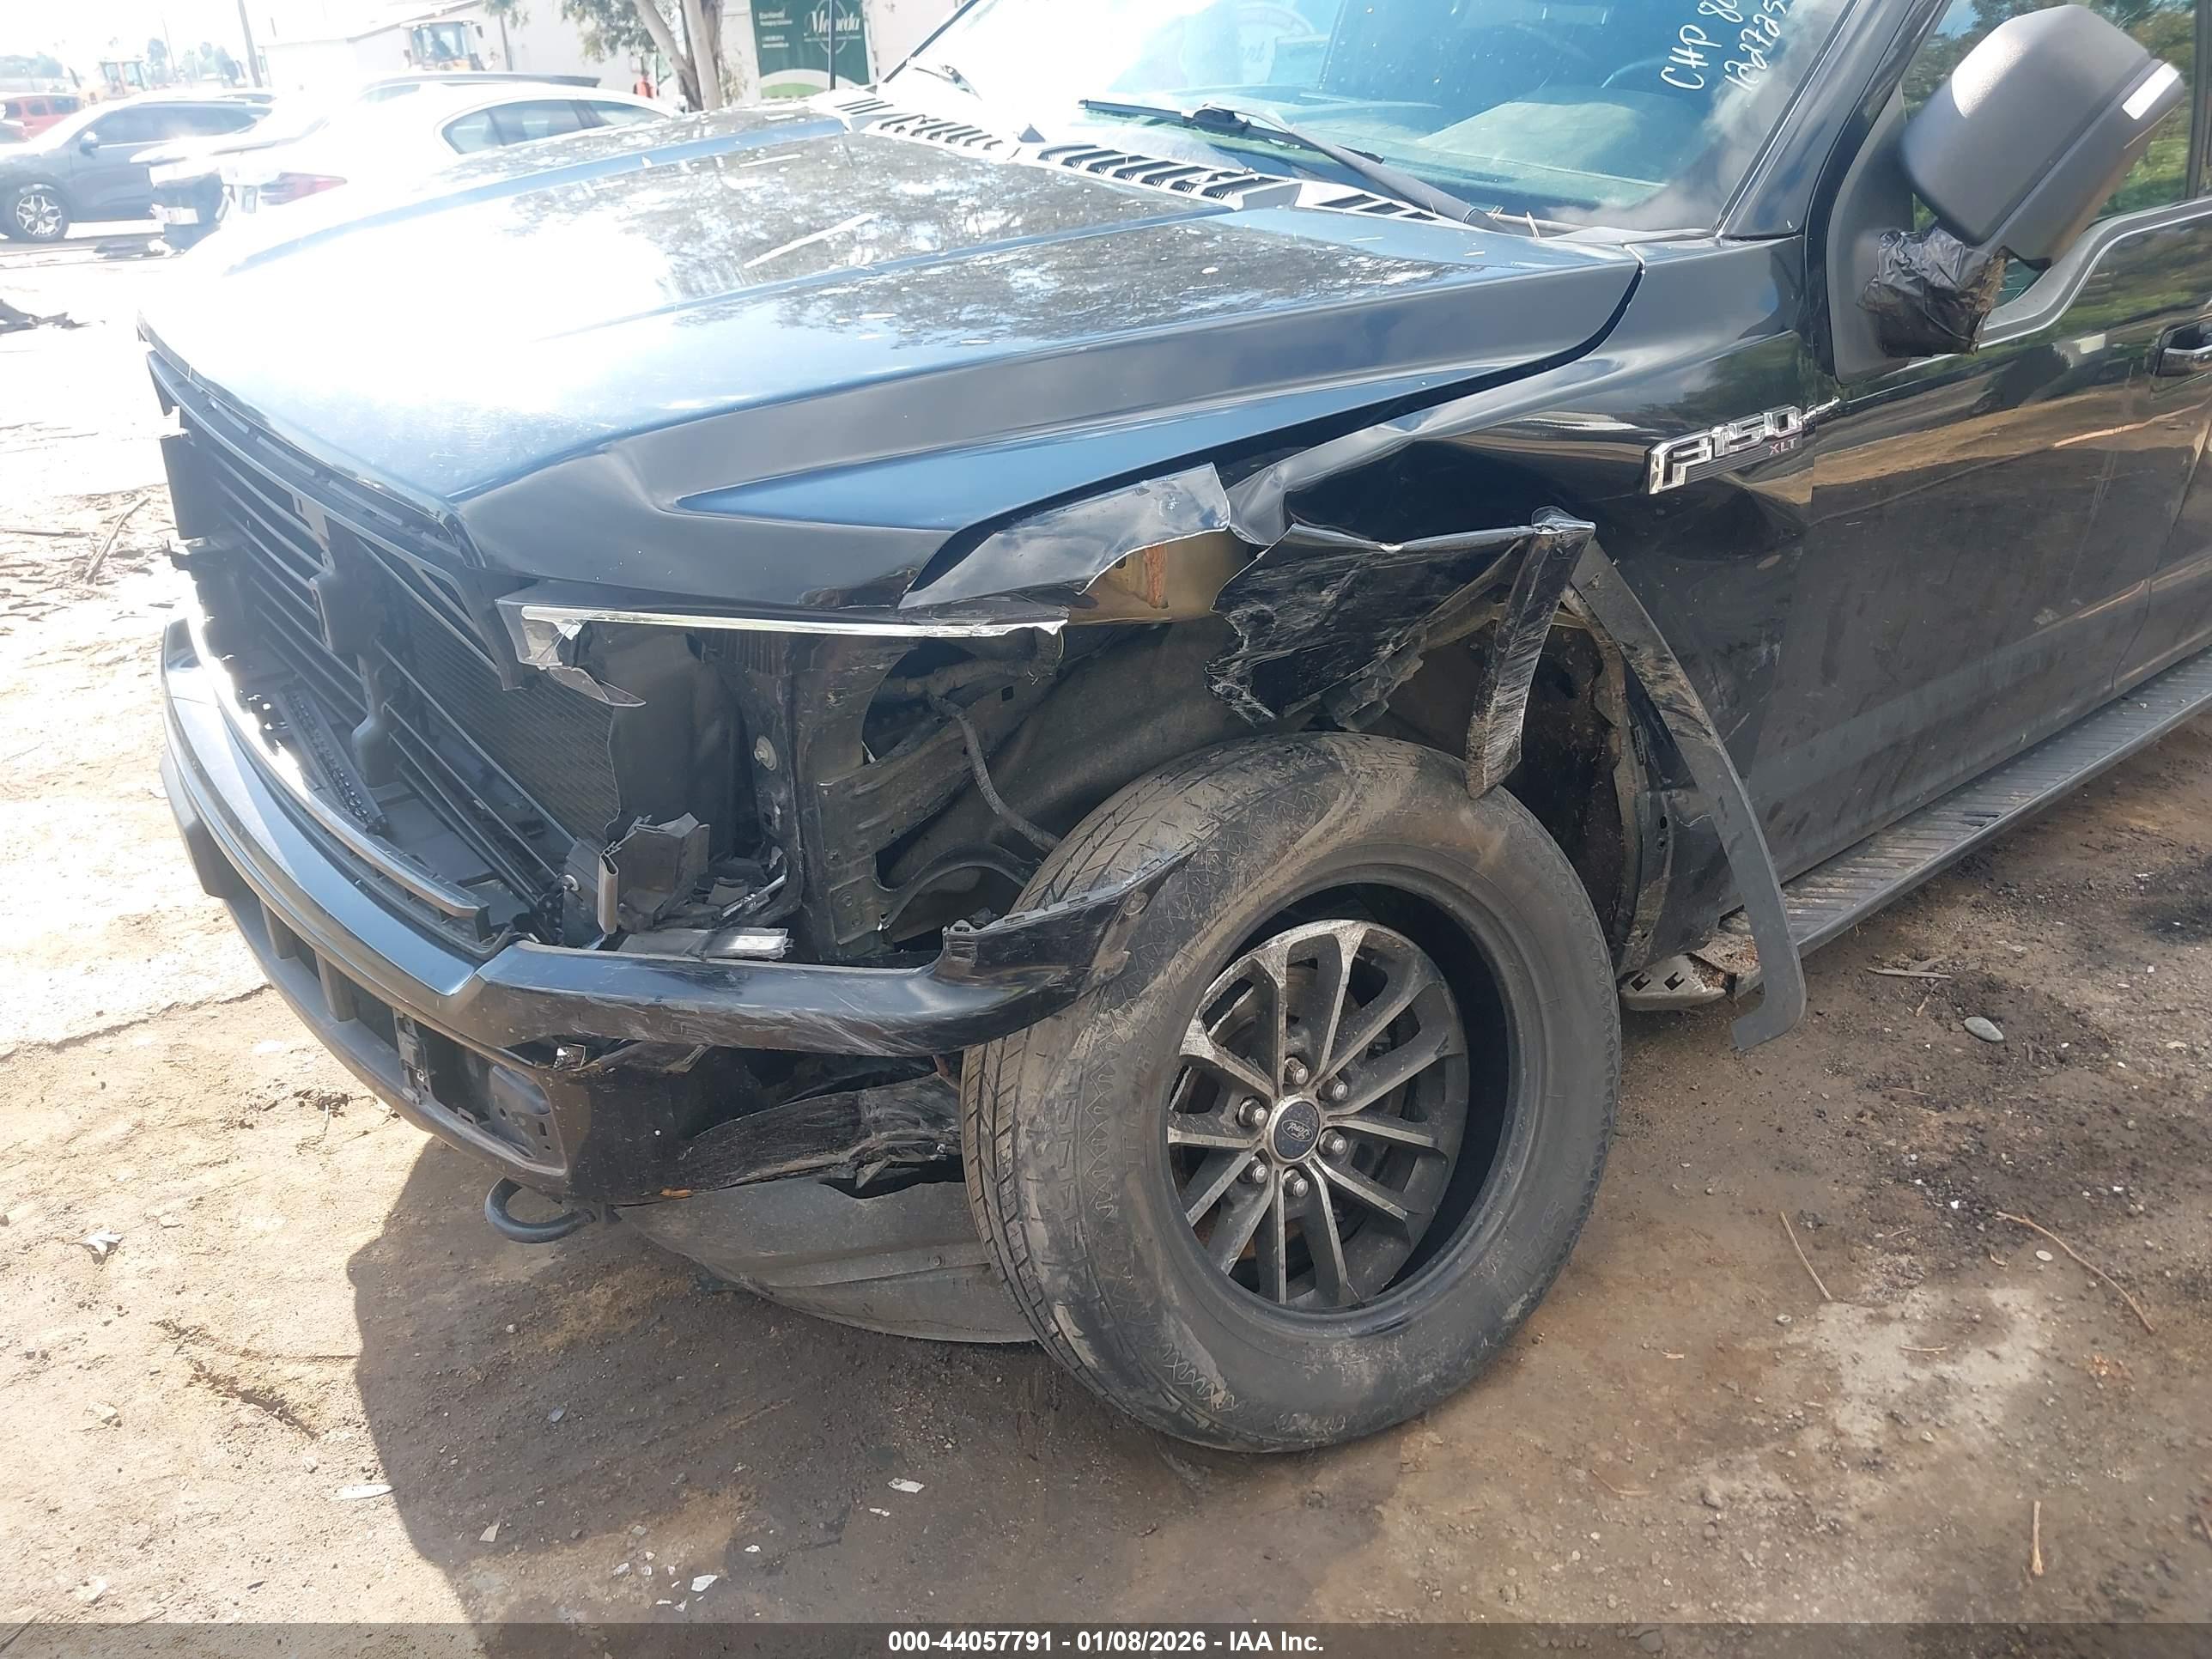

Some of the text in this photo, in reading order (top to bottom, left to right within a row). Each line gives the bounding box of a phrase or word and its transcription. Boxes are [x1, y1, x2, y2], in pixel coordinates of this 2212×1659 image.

[1660, 24, 1723, 90] CHP
[1768, 437, 1797, 456] XLT
[1285, 1121, 1312, 1140] Ford
